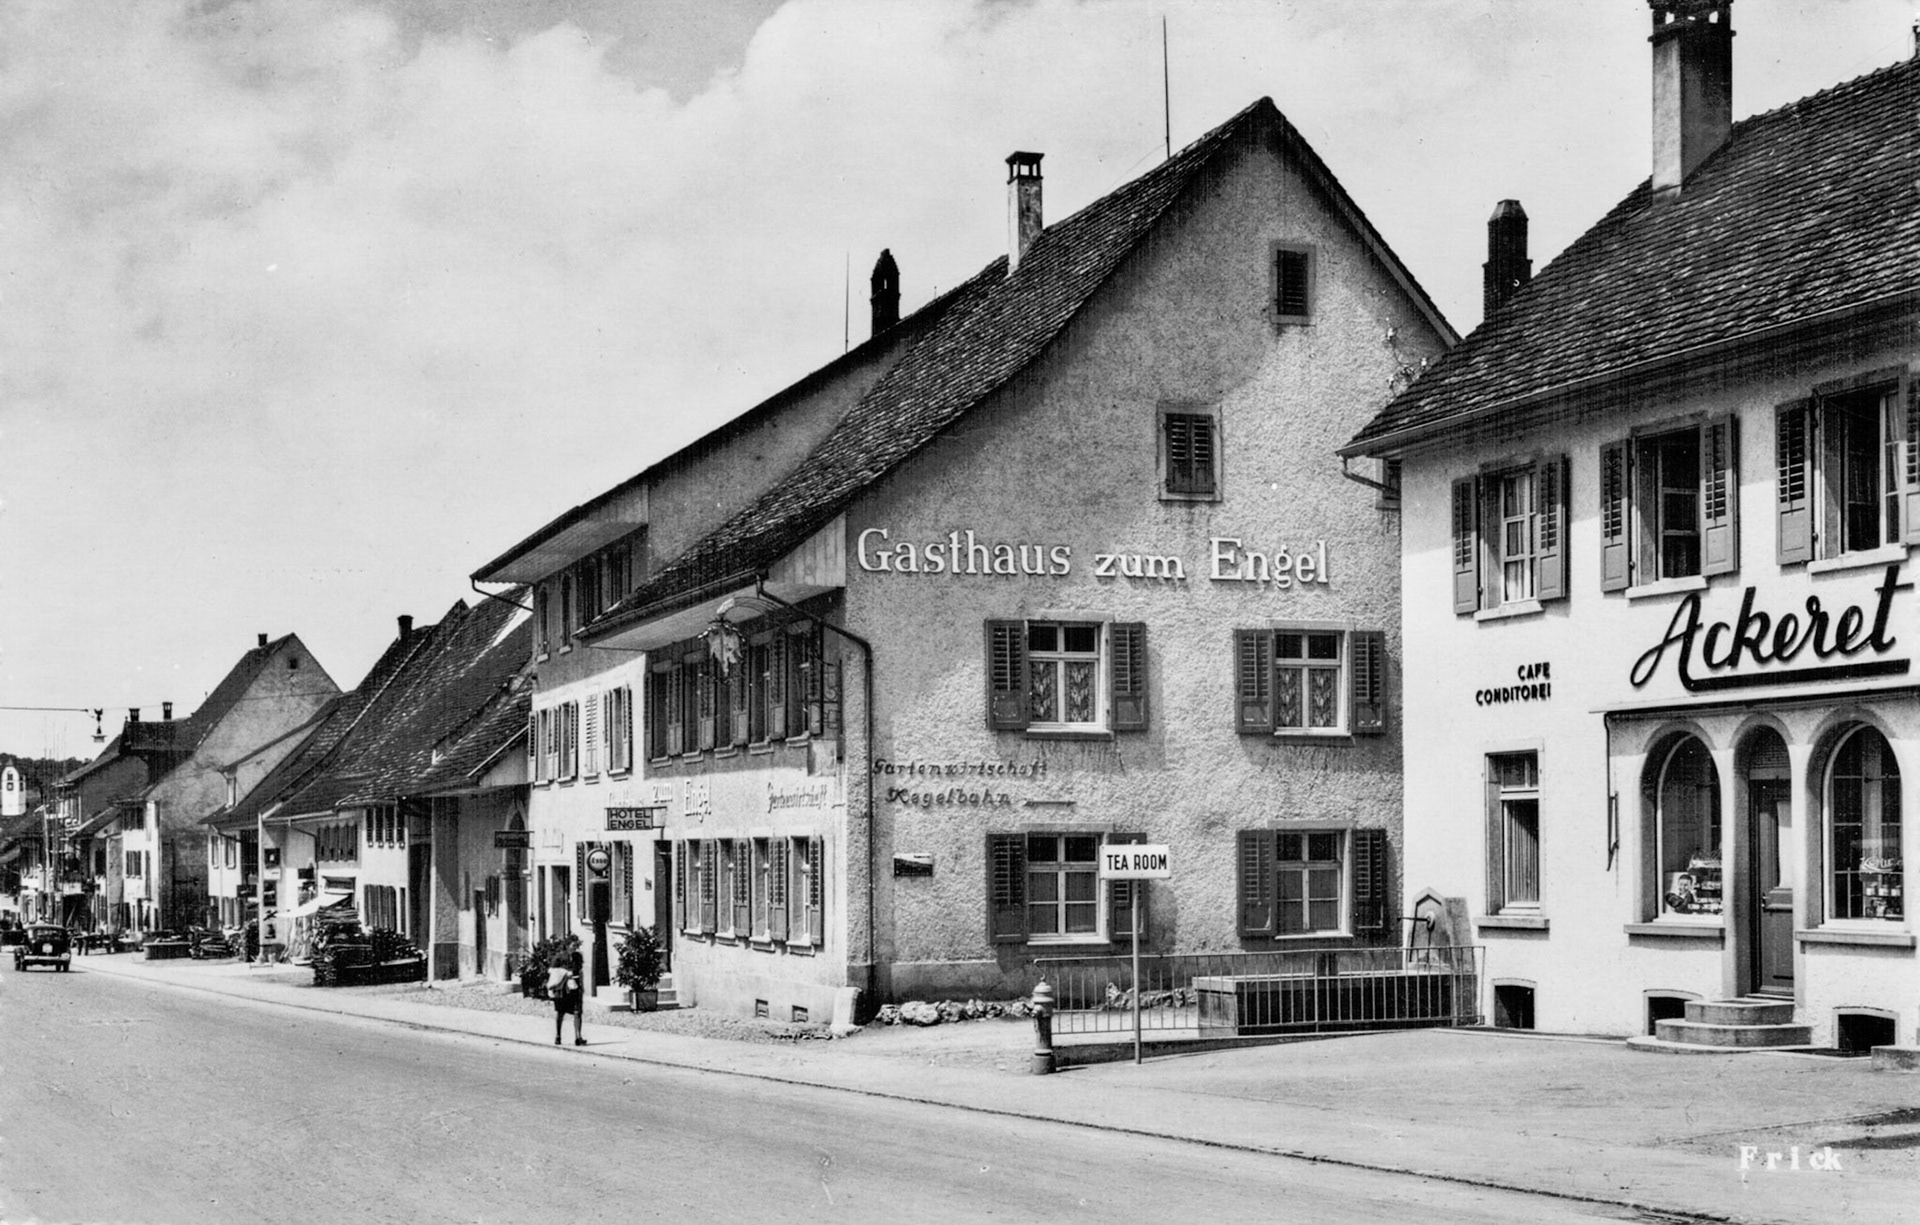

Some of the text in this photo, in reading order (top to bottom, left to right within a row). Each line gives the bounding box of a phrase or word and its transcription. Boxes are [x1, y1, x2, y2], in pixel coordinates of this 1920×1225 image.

[856, 527, 1329, 588] Gasthaus zum Engel
[1629, 564, 1914, 692] Ackeret
[1517, 661, 1551, 682] CAFE
[1475, 682, 1551, 707] CONDITOREI
[873, 758, 1048, 777] Gartenwirtschaft
[885, 786, 1012, 808] Kegelbahn
[610, 809, 651, 818] HOTEL
[610, 820, 651, 830] ENGEL
[1107, 854, 1167, 870] TEA ROOM
